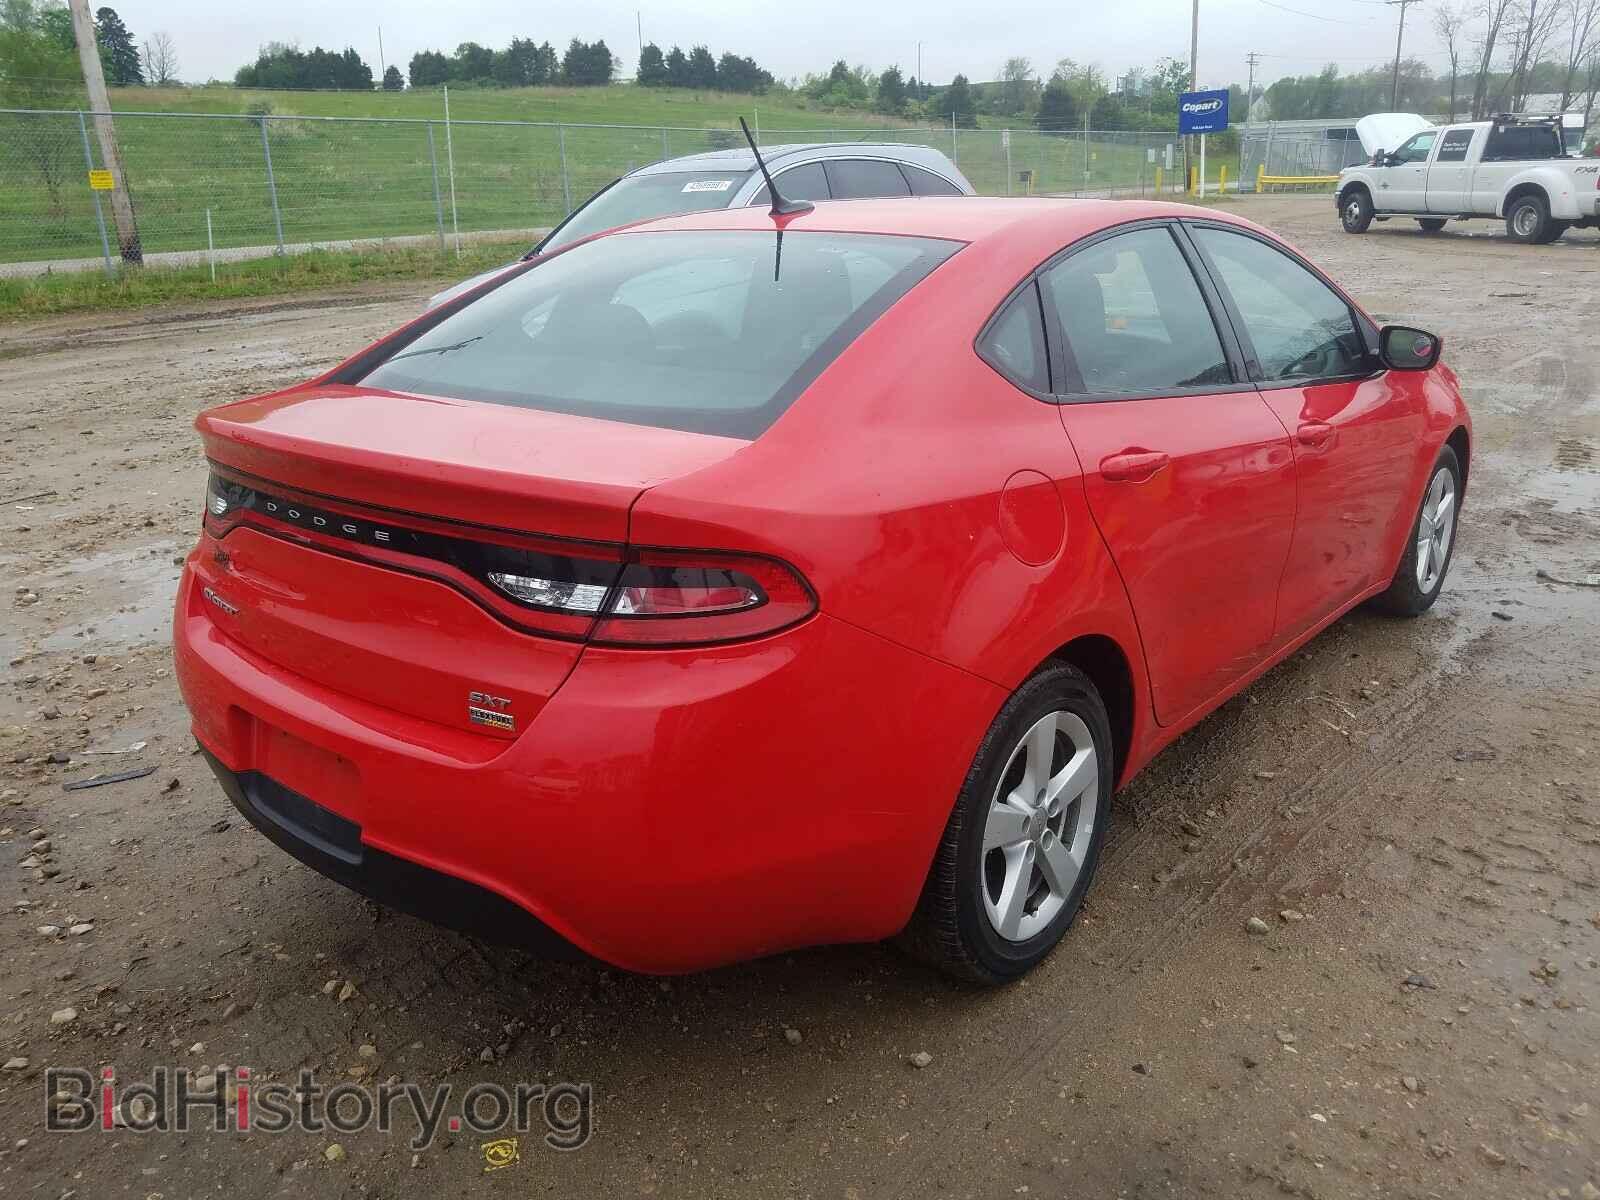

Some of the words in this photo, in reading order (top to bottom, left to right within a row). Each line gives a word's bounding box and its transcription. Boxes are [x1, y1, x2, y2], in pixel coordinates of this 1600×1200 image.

[1182, 101, 1218, 112] Copart
[266, 502, 391, 542] DODGE
[470, 691, 511, 709] SXT
